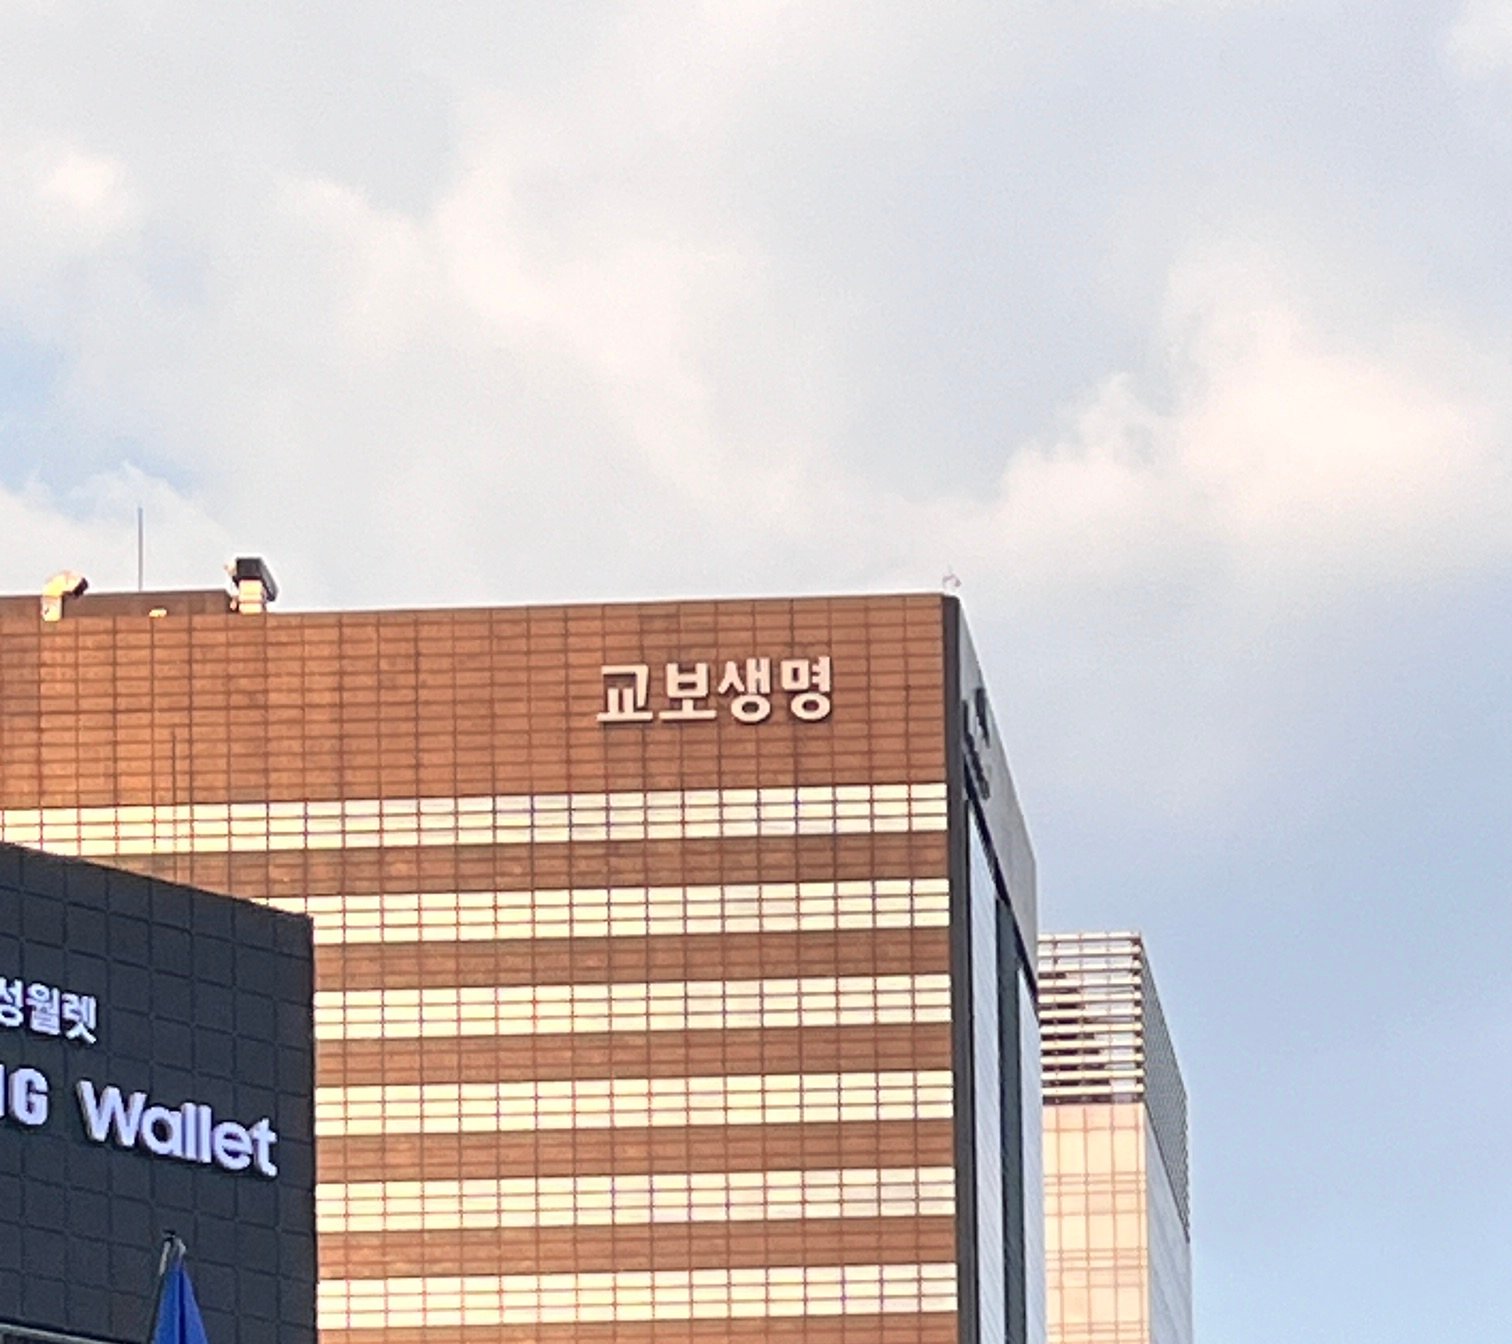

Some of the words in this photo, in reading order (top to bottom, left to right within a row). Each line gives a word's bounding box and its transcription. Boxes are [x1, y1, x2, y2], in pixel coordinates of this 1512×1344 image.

[596, 657, 833, 724] 교보생명
[0, 1063, 49, 1126] G
[77, 1080, 278, 1177] Wallet
